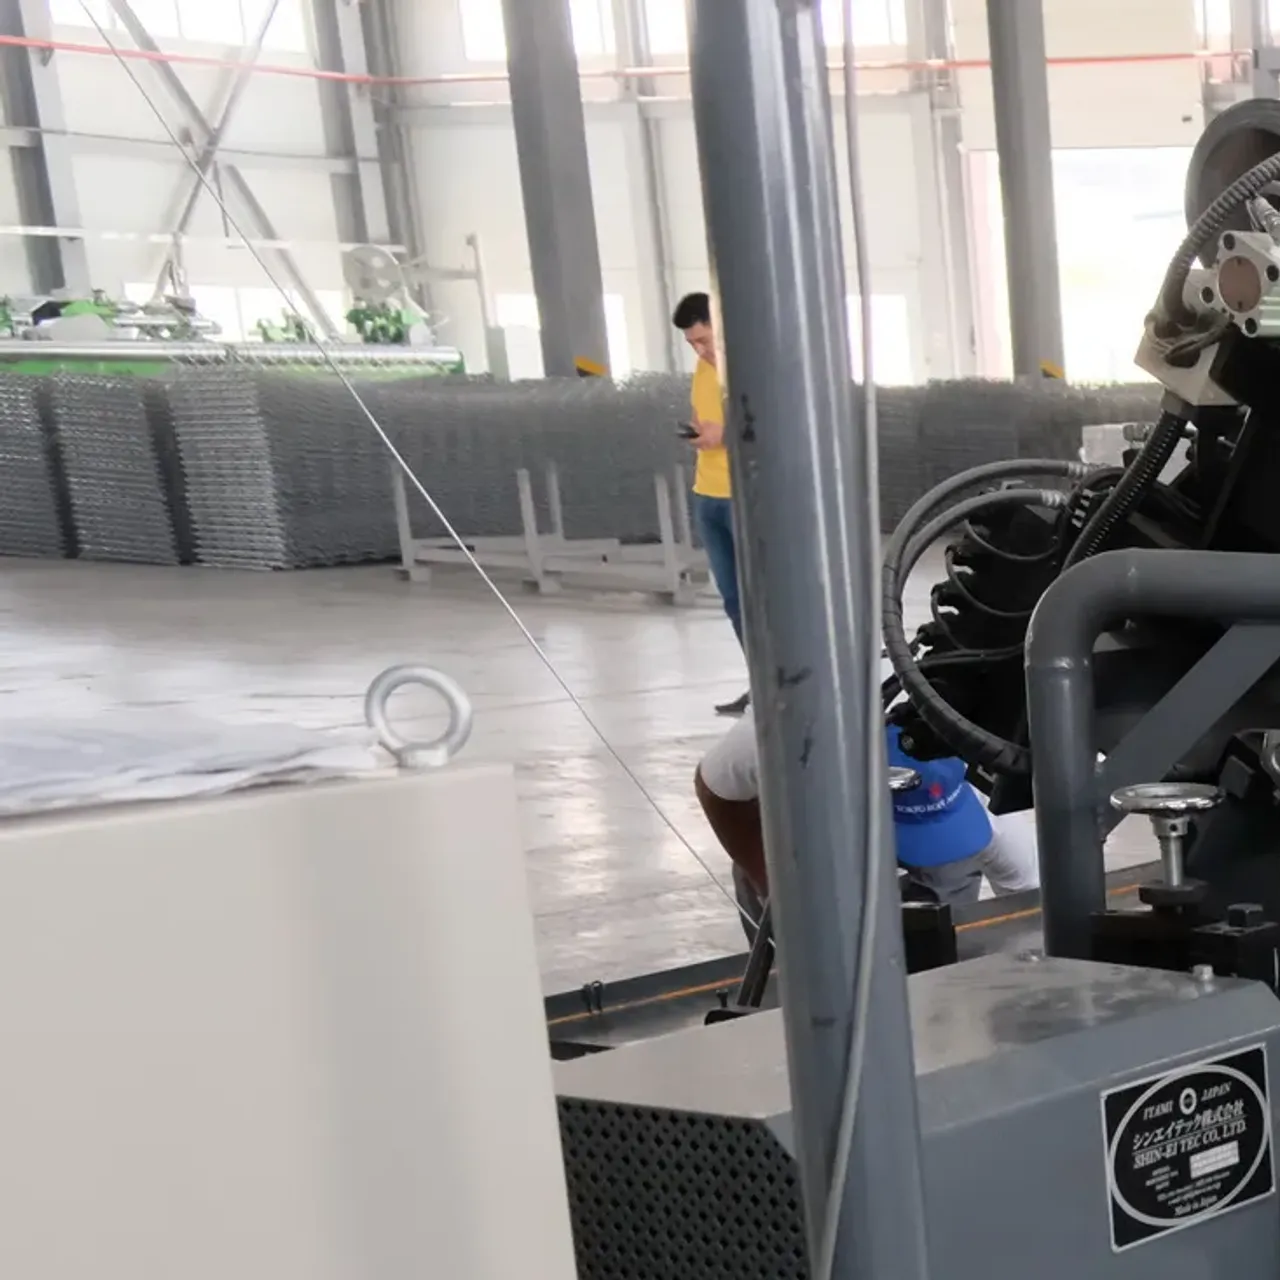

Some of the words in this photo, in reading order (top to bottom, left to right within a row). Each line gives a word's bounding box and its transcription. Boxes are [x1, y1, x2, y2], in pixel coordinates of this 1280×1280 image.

[1201, 1081, 1232, 1102] JAPAN
[1143, 1100, 1174, 1120] ITAMI
[1132, 1098, 1245, 1151] シンエイテック株式会社
[1132, 1142, 1178, 1169] SHIN-EI
[1180, 1134, 1202, 1154] TEC
